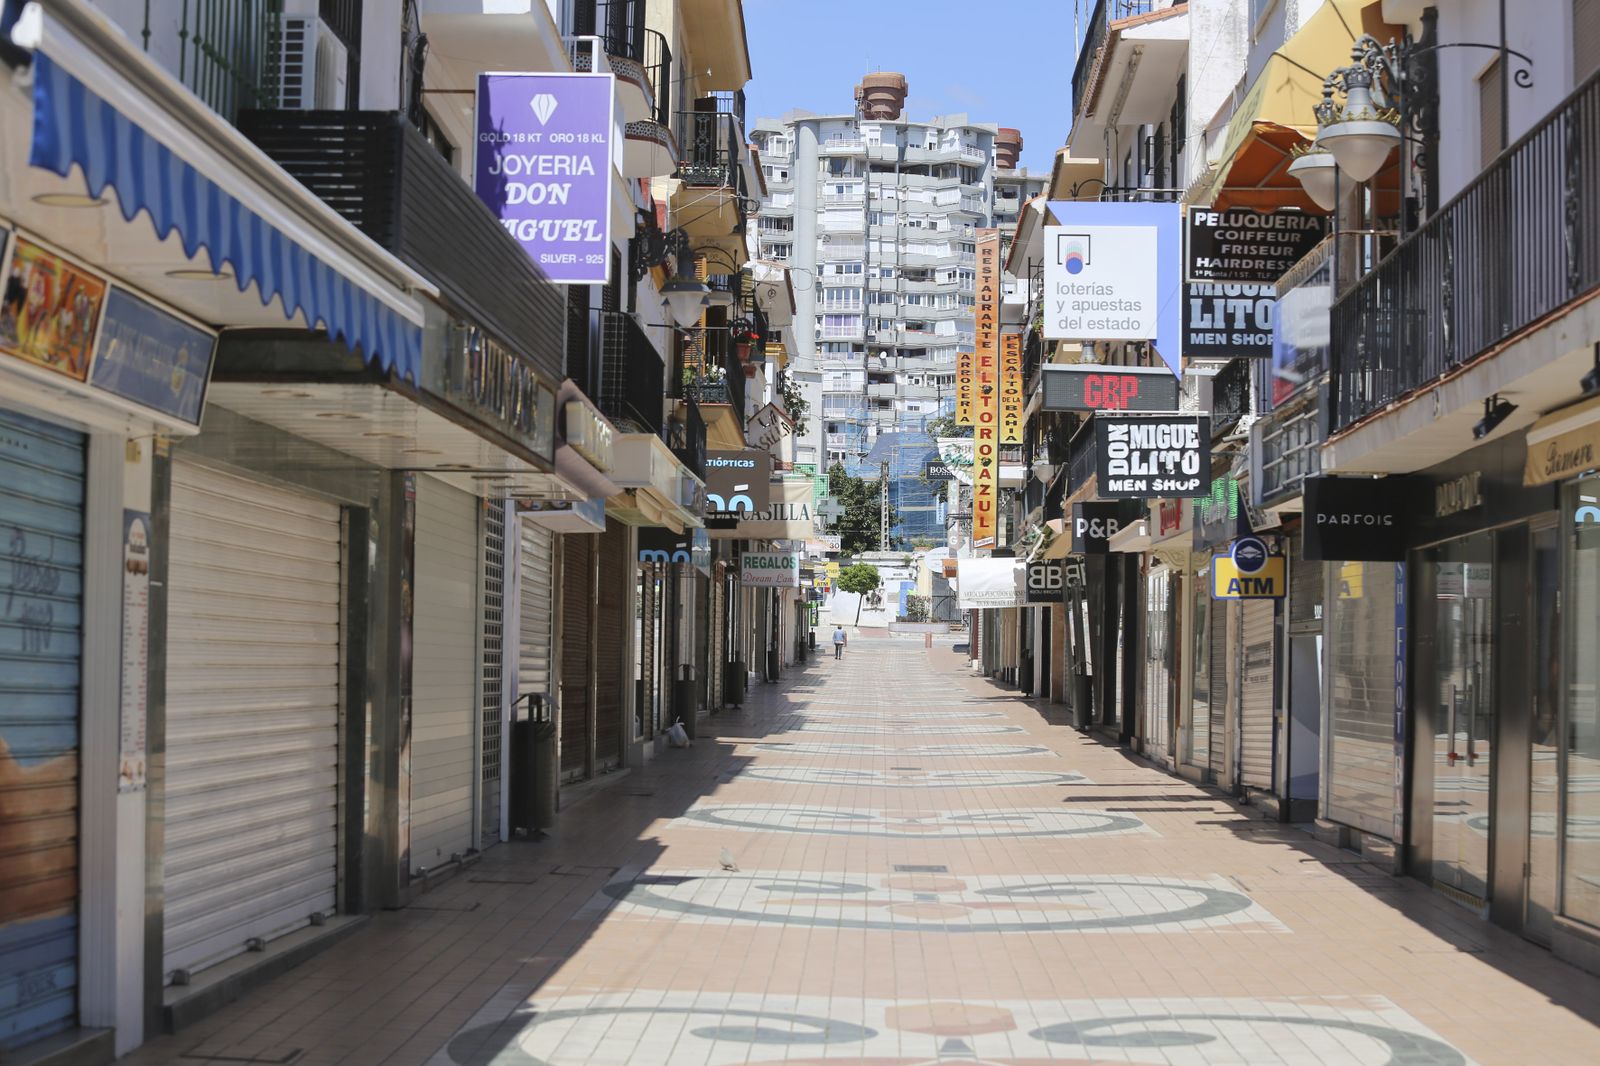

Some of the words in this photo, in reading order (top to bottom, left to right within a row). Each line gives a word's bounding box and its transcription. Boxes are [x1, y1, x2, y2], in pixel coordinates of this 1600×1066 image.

[480, 133, 511, 143] GOLD
[513, 133, 525, 143] 18
[527, 133, 543, 143] KT
[550, 133, 574, 143] ORO
[577, 133, 590, 143] 18
[591, 133, 606, 144] KL
[488, 154, 595, 176] JOYERIA
[505, 182, 572, 205] DON
[1194, 212, 1320, 230] PELUQUERIA
[1213, 230, 1301, 243] COIFFEUR
[540, 253, 577, 264] SILVER
[585, 254, 604, 264] 925
[1221, 244, 1294, 256] FRISEUR
[1056, 281, 1114, 296] loterías
[981, 248, 993, 349] RESTAURANTE
[1056, 300, 1065, 314] y
[1071, 299, 1142, 314] apuestas
[1189, 298, 1274, 330] LITO
[1058, 316, 1083, 331] del
[1087, 316, 1141, 331] estado
[1190, 333, 1227, 345] MEN
[980, 356, 993, 384] EL
[960, 354, 971, 423] ARROCERIA
[979, 395, 993, 457] TORO
[1005, 405, 1018, 442] BAHIA
[1129, 424, 1200, 450] MIGUE
[1107, 424, 1130, 476] DON
[1130, 450, 1200, 477] LITO
[1108, 478, 1147, 492] MEN
[1152, 478, 1201, 491] SHOP
[978, 468, 993, 528] AZUL
[1316, 513, 1393, 526] PARFOIS
[743, 555, 797, 569] REGALOS
[743, 571, 772, 583] Dream
[1226, 577, 1274, 595] ATM
